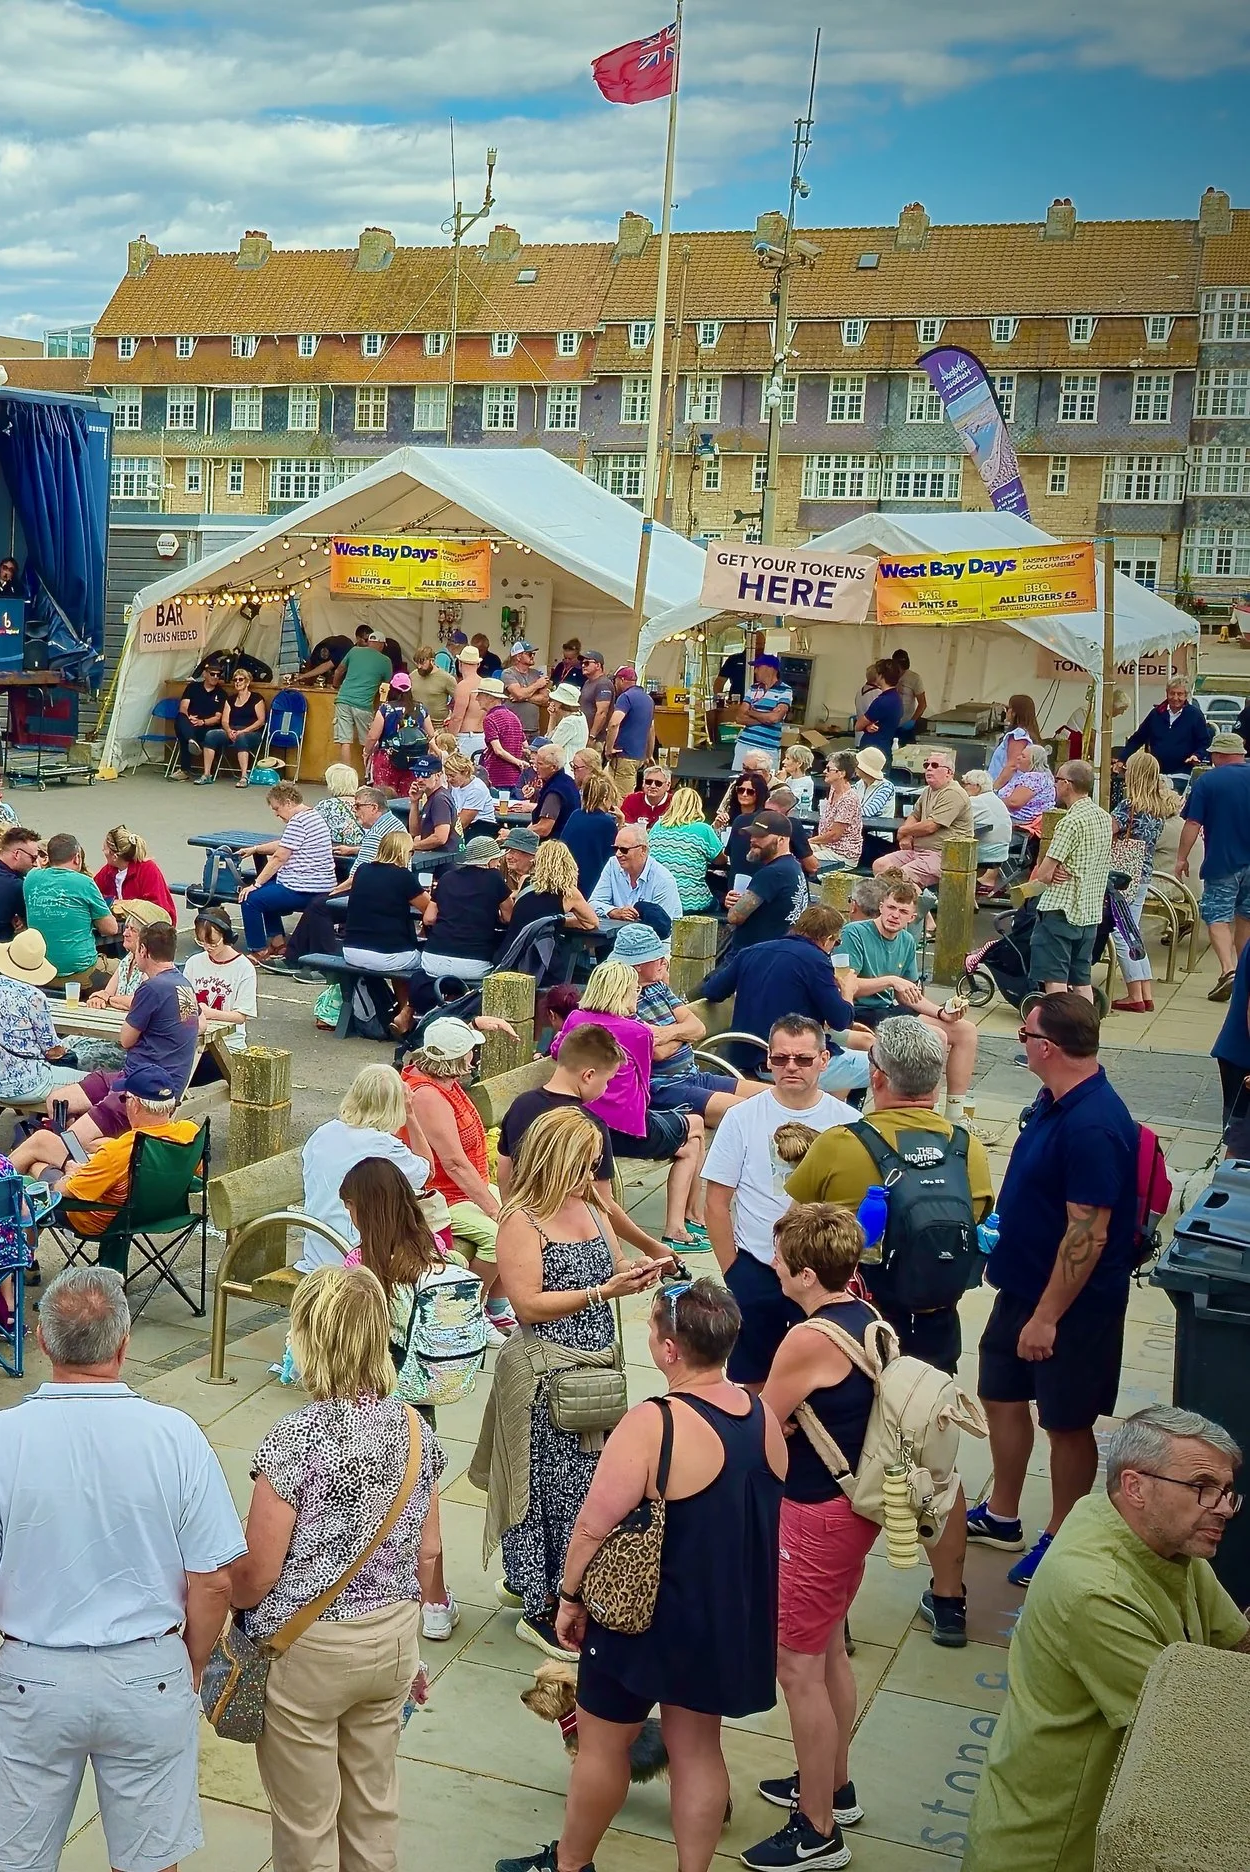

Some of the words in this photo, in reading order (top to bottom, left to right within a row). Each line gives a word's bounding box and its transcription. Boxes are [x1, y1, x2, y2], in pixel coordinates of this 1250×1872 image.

[334, 542, 370, 557] West
[372, 544, 400, 562] Bay
[400, 545, 438, 564] Days
[717, 552, 748, 568] GET
[751, 556, 796, 573] YOUR
[800, 562, 866, 580] TOKENS
[880, 562, 928, 578] West
[930, 560, 967, 580] Bay
[968, 558, 1018, 578] Days
[1044, 561, 1076, 570] CHARITIES
[360, 568, 378, 578] BAR
[360, 577, 382, 586] PINTS
[435, 580, 464, 588] BURGERS
[738, 572, 838, 609] HERE
[1024, 582, 1050, 593] BBQ
[918, 590, 940, 600] BAR
[1000, 595, 1017, 604] ALL
[1018, 592, 1062, 602] BURGERS
[1064, 591, 1077, 600] £5
[919, 600, 944, 609] PINTS
[946, 600, 958, 608] £5
[156, 603, 184, 627] BAR
[144, 632, 170, 643] TOKENS
[171, 630, 198, 641] NEEDED
[916, 1146, 933, 1155] THE
[904, 1154, 933, 1164] NORTH
